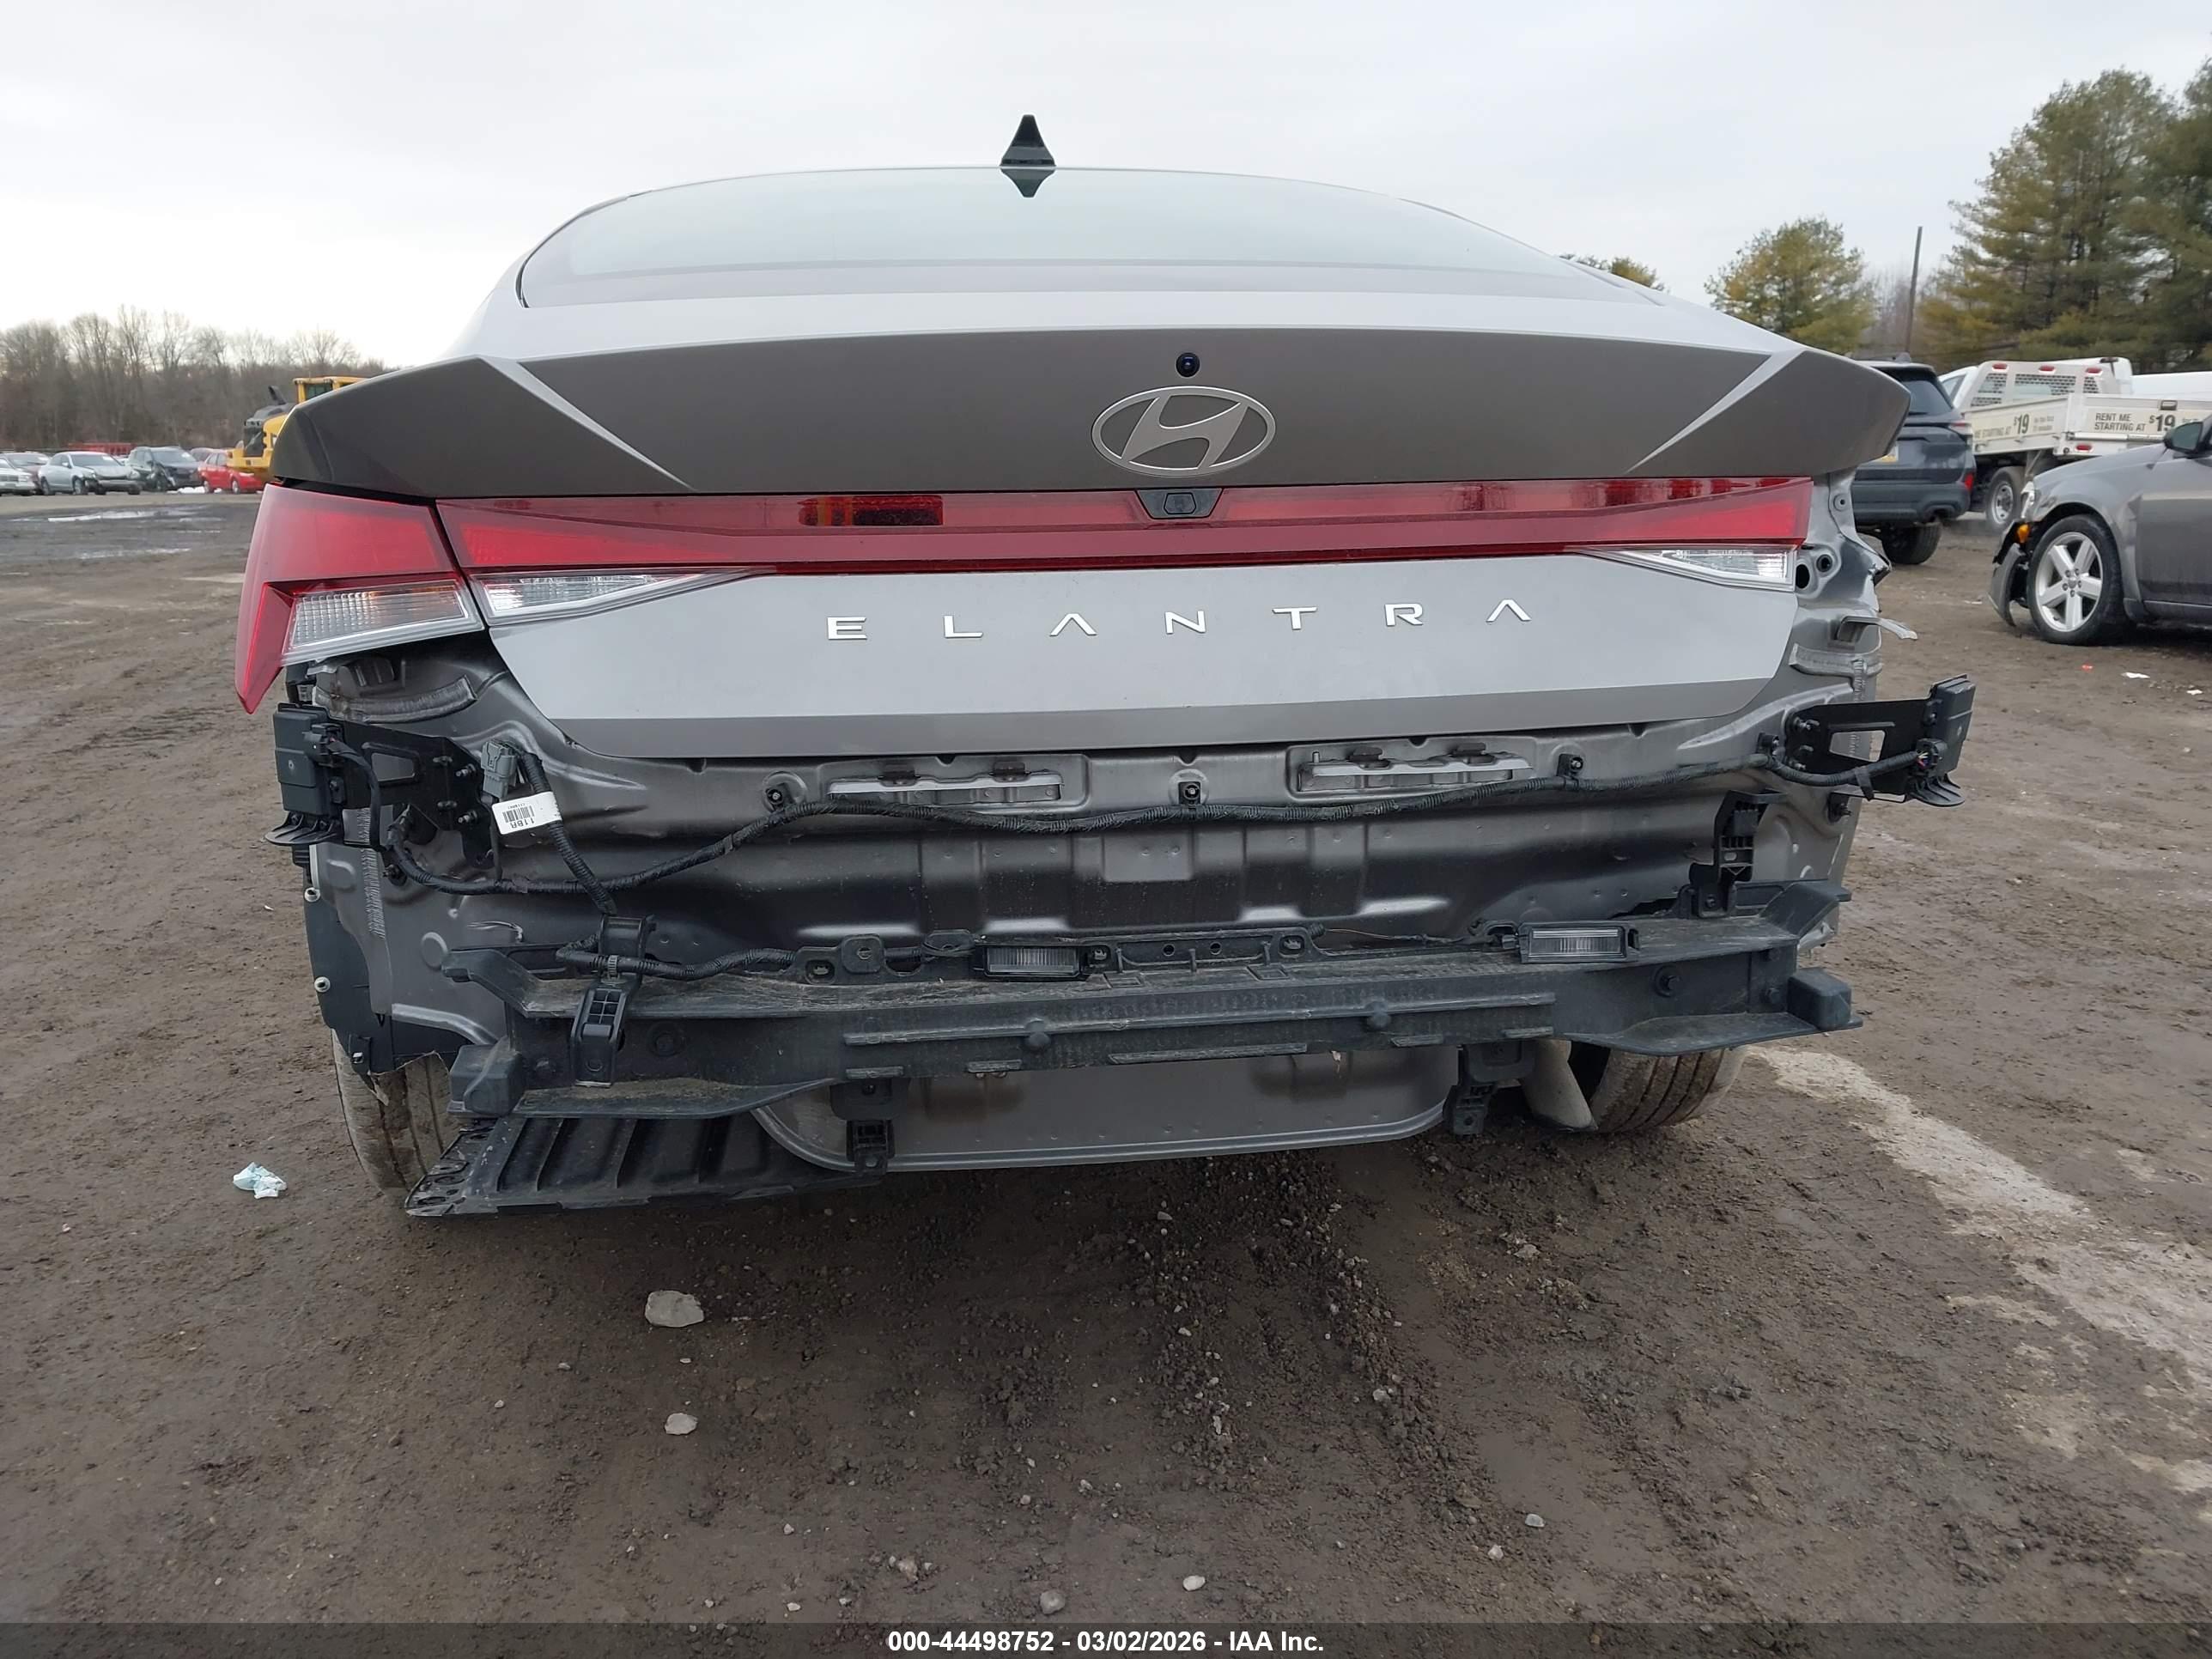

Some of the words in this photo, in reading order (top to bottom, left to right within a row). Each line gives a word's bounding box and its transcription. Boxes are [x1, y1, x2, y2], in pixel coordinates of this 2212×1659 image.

[2014, 414, 2030, 434] $19
[2095, 412, 2117, 422] RENT
[2118, 413, 2131, 422] ME
[2148, 414, 2176, 432] $19
[2094, 422, 2134, 431] STARTING
[827, 599, 1531, 640] ELANTRA
